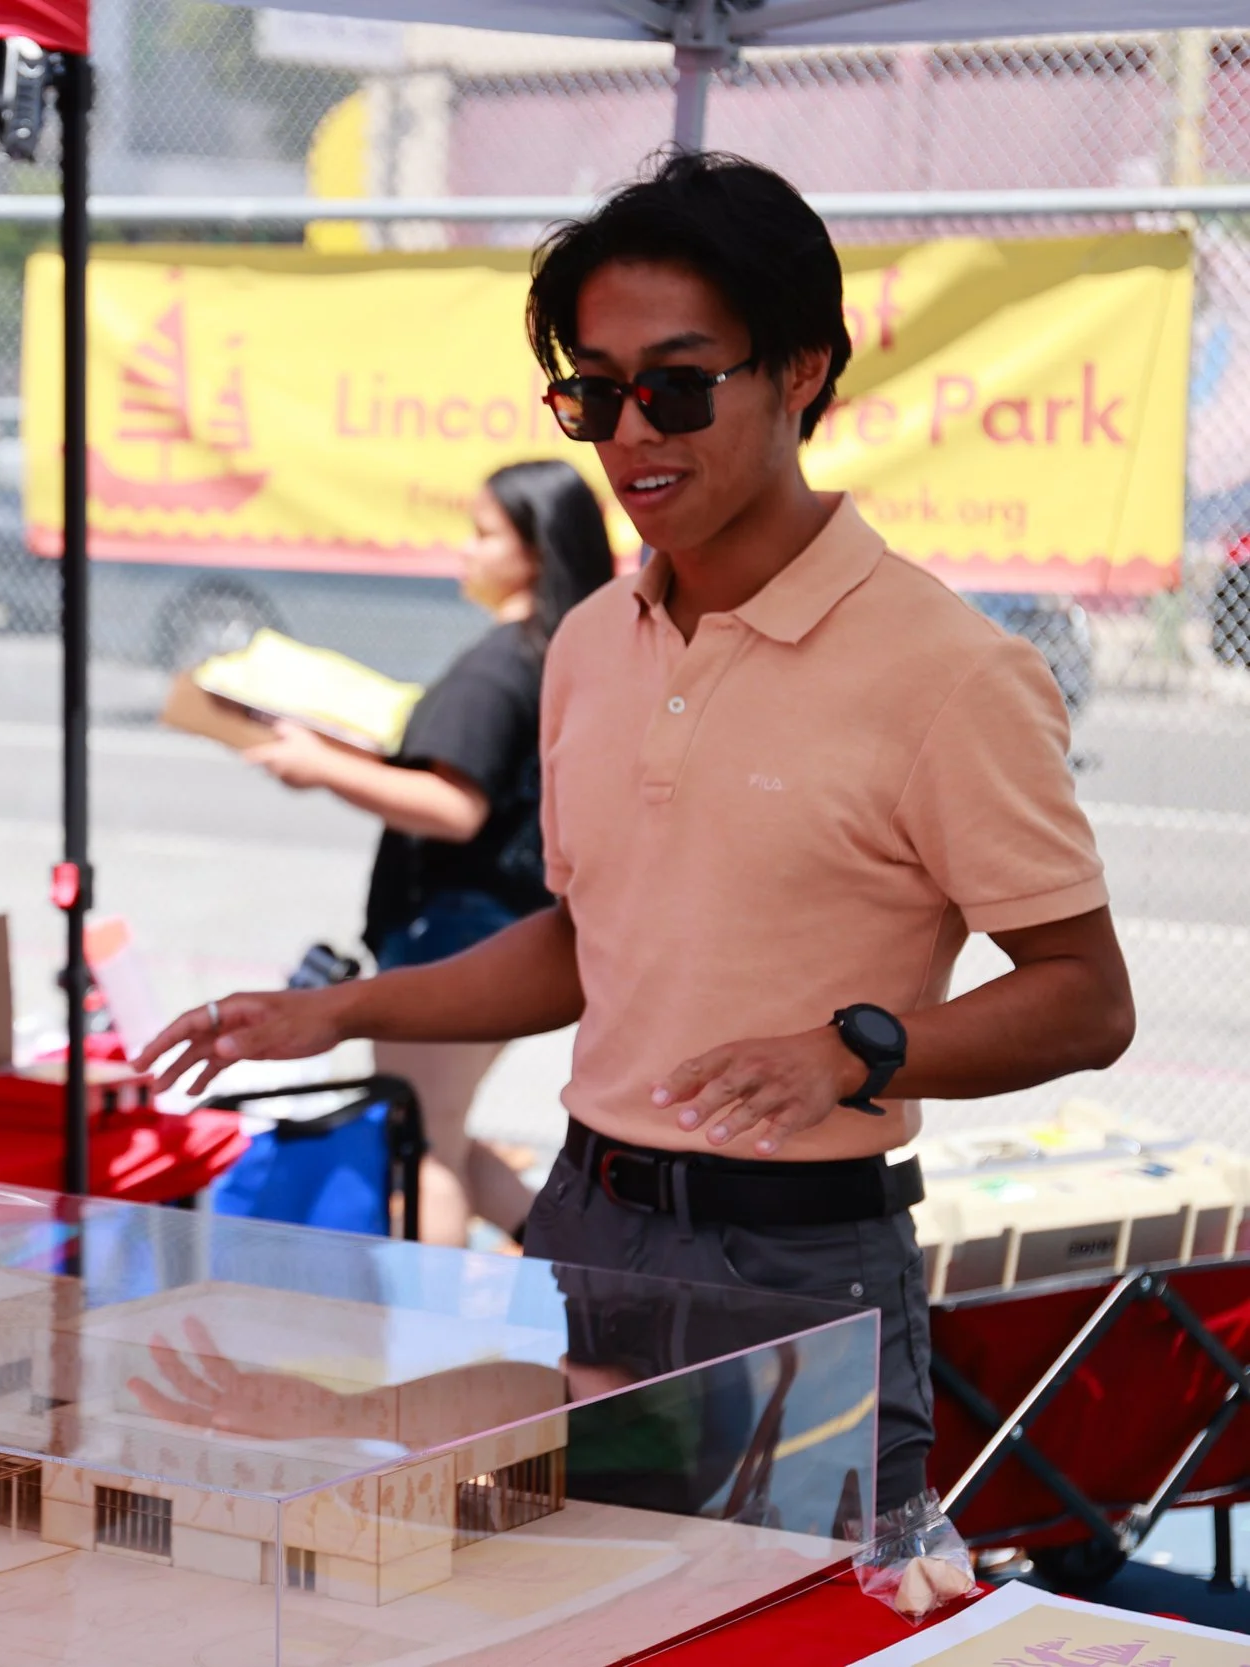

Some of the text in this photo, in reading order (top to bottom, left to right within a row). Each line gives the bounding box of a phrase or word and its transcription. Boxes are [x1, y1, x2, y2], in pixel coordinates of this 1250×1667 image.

[336, 367, 561, 441] Lincol
[930, 362, 1127, 446] Park
[749, 773, 782, 791] FILA
